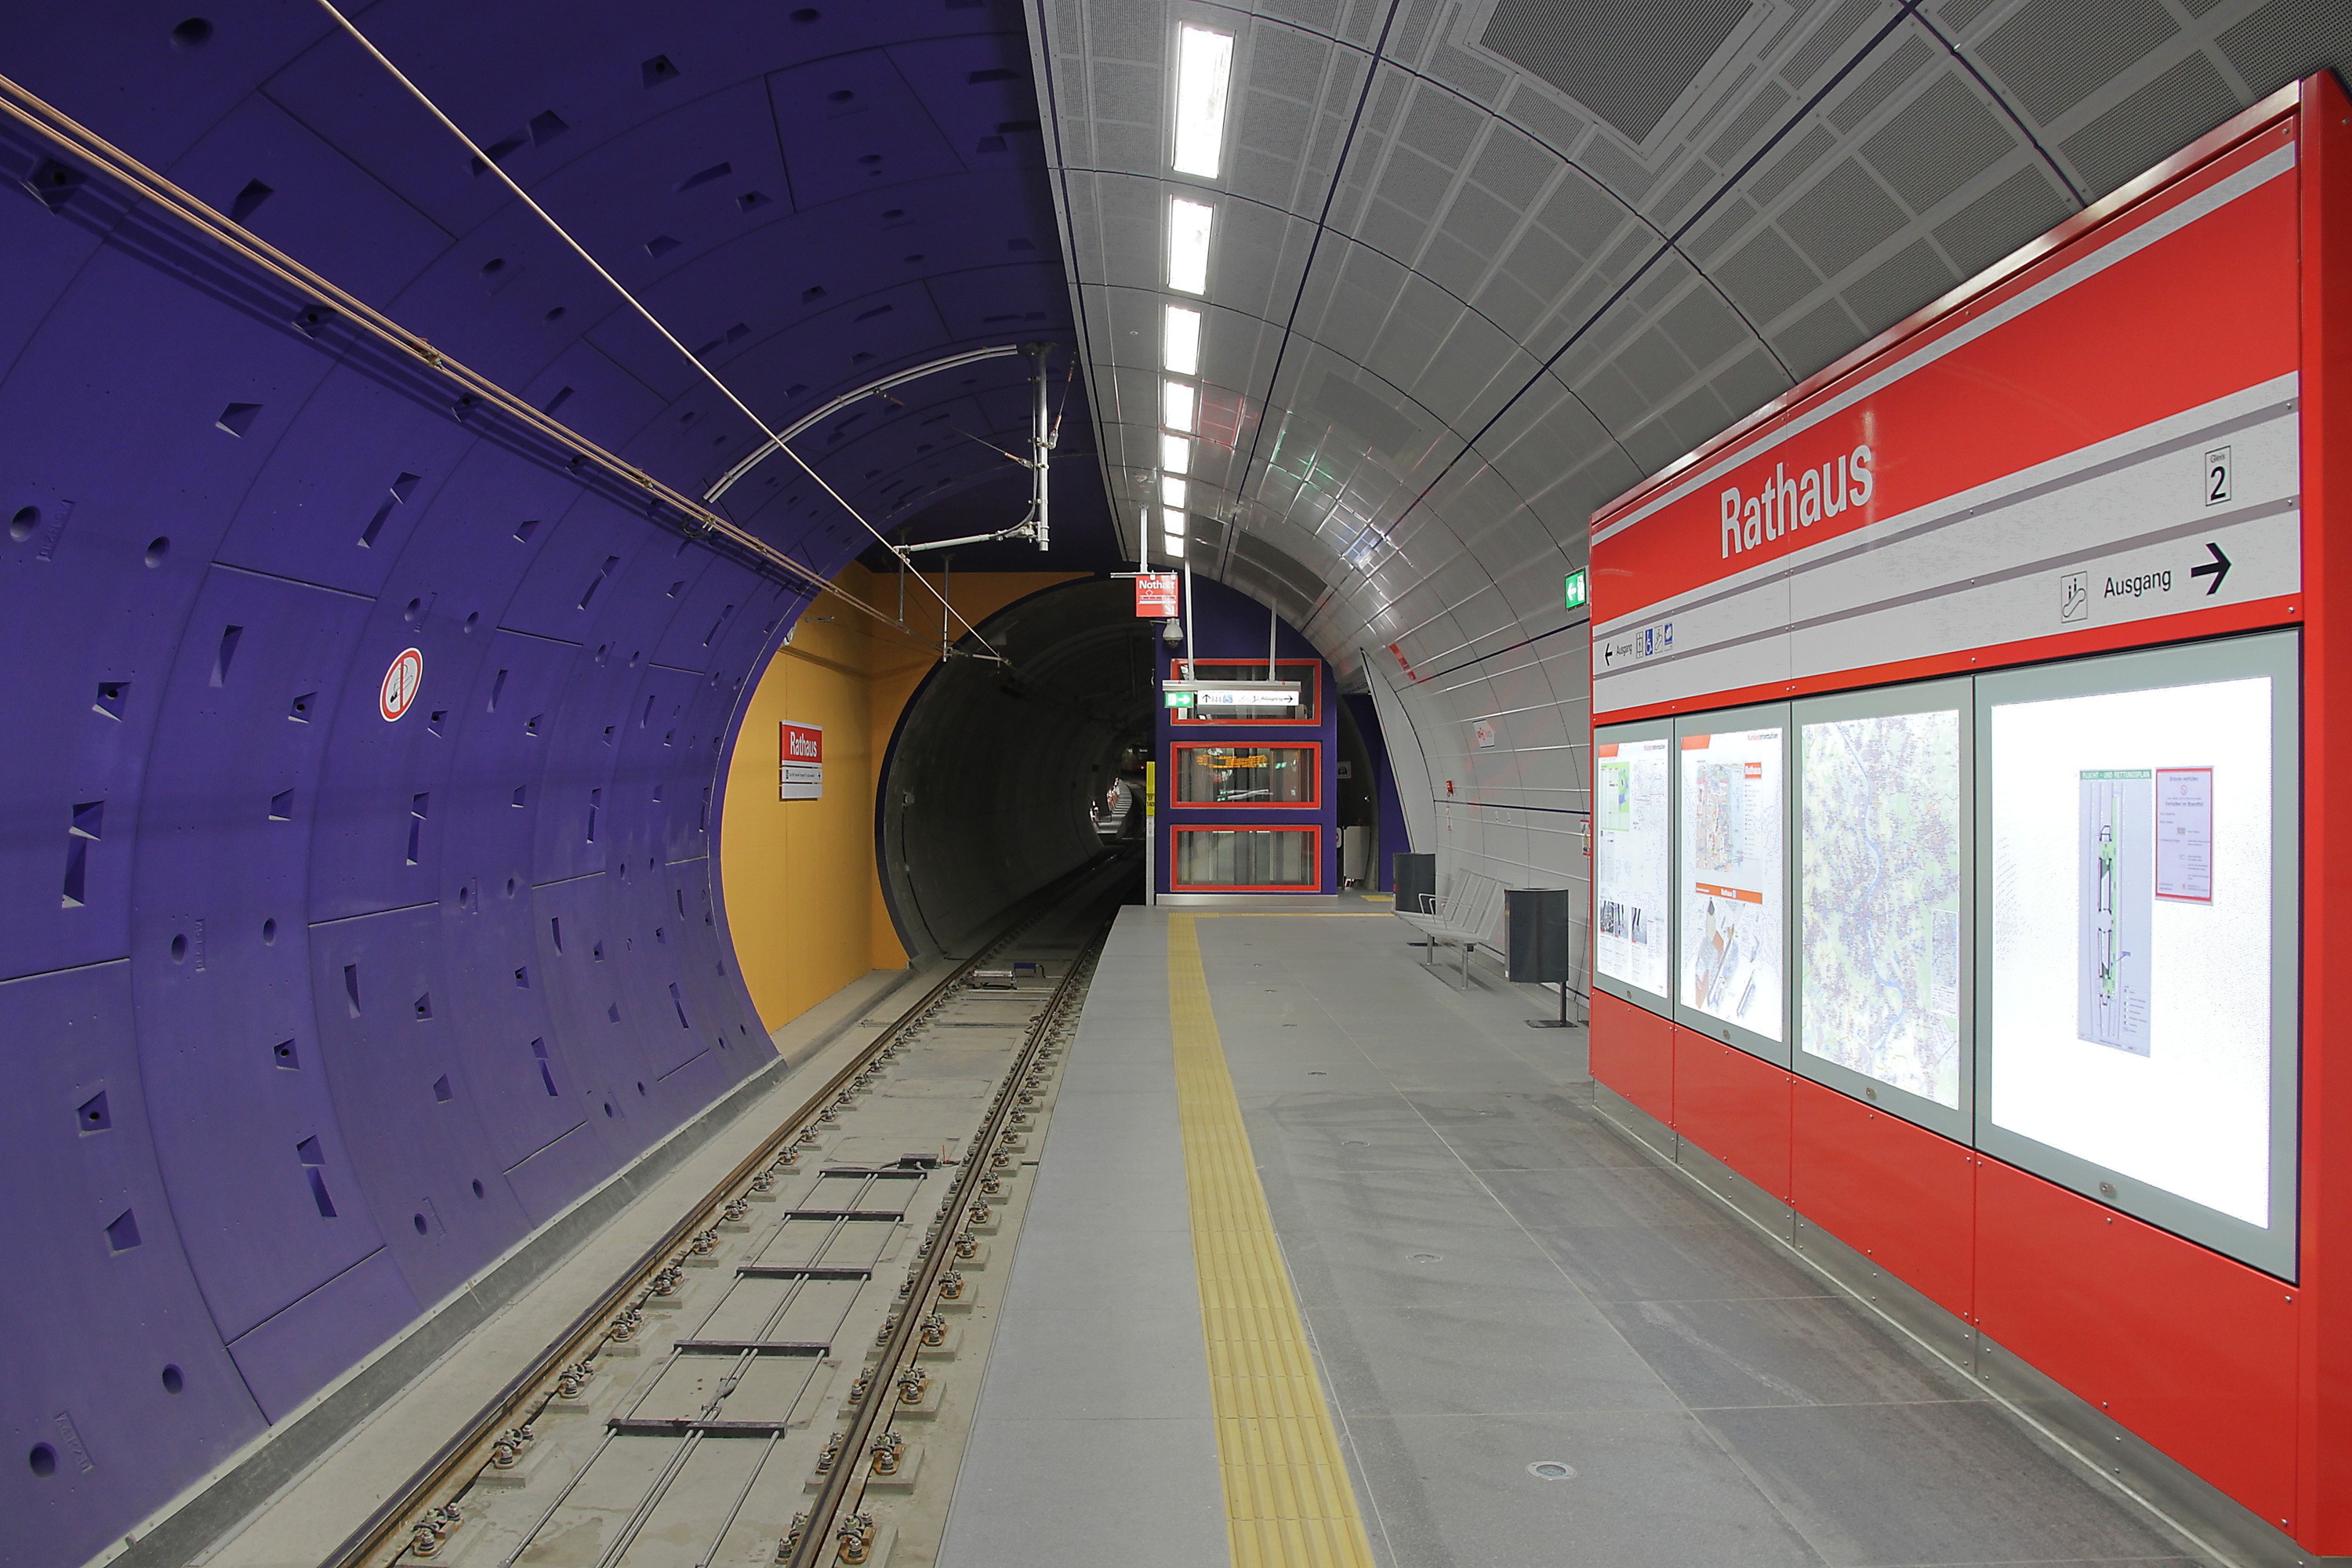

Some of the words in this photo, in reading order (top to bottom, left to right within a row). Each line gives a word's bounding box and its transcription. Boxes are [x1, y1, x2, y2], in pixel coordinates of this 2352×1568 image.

[2211, 454, 2226, 463] Gleis
[2211, 466, 2226, 500] 2
[1721, 445, 1873, 559] Rathaus
[1139, 580, 1175, 589] Nothalt
[2103, 570, 2171, 598] Ausgang
[1616, 644, 1633, 657] Ausgang
[790, 731, 818, 757] Rathaus
